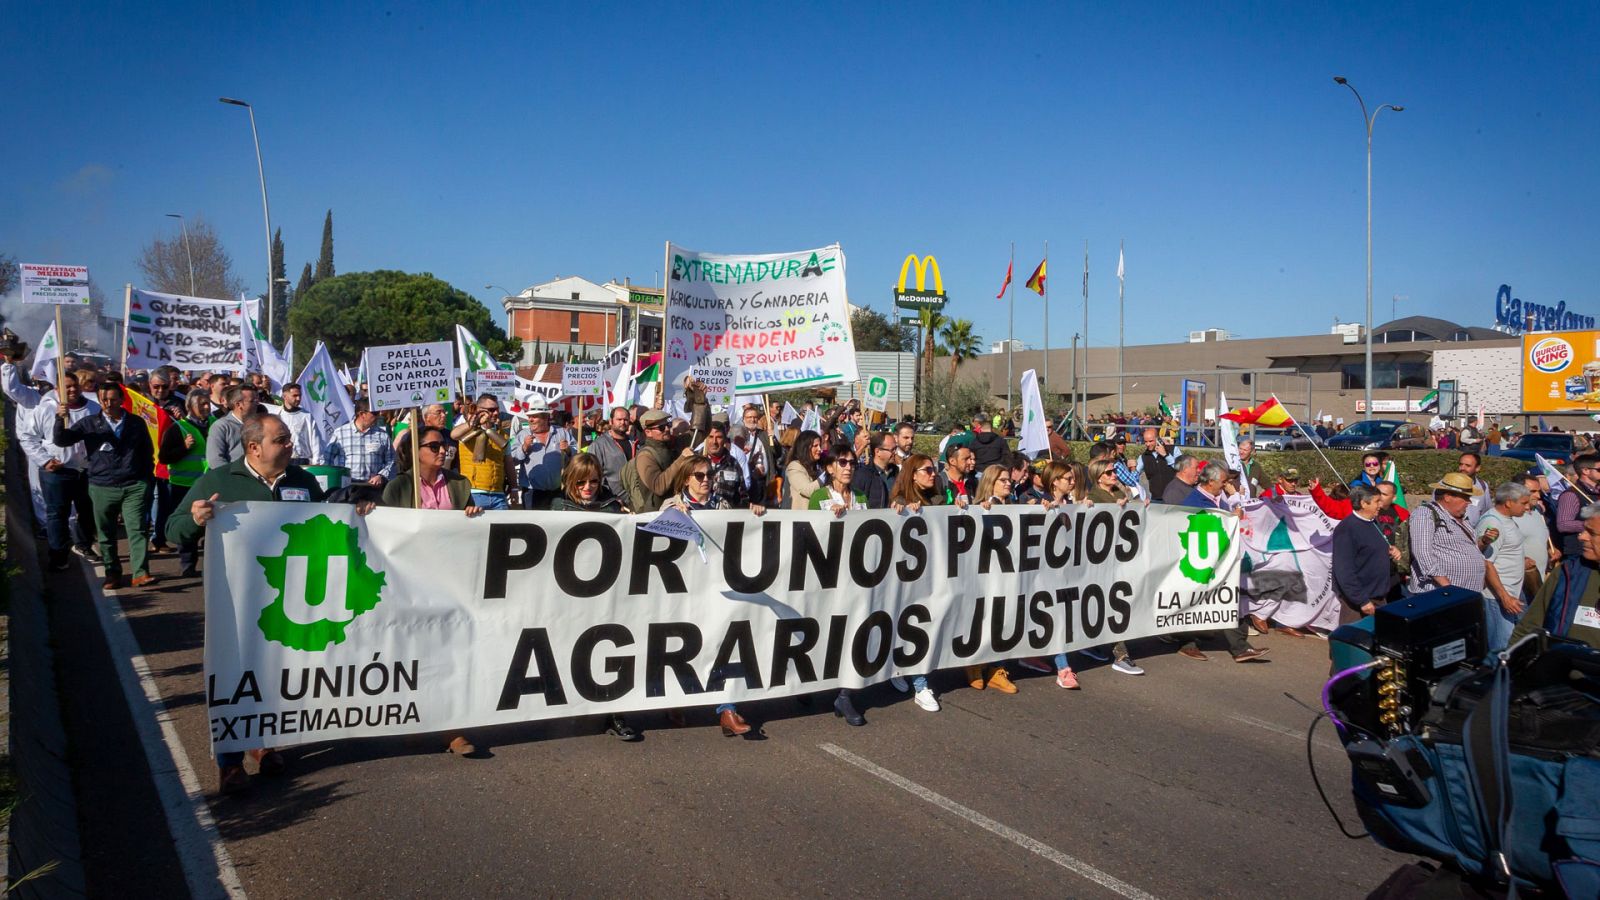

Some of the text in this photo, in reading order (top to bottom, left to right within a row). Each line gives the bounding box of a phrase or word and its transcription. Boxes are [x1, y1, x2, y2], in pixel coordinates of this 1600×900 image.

[630, 293, 656, 304] HOTEL
[670, 289, 735, 311] AGRICULTURA
[750, 290, 830, 309] GANADERIA
[898, 294, 943, 304] McDonald's
[670, 315, 694, 331] PERO
[788, 316, 806, 327] NO
[812, 312, 830, 323] LA
[152, 330, 193, 347] PERO
[692, 329, 797, 351] DEFIENDEN
[145, 340, 172, 362] LA
[387, 348, 431, 360] PAELLA
[1535, 343, 1567, 358] BURGER
[1536, 349, 1568, 366] KING
[380, 357, 442, 371] ESPAÑOLA
[715, 356, 731, 368] DE
[377, 368, 446, 383] CON ARROZ
[743, 365, 825, 383] DERECHAS
[376, 378, 448, 393] DE VIETNAM
[483, 510, 1141, 600] POR UNOS PRECIOS
[1157, 591, 1182, 610] LA
[1156, 610, 1239, 628] EXTREMADUR
[495, 580, 1134, 712] AGRARIOS JUSTOS
[208, 651, 420, 708] LA UNIÓN
